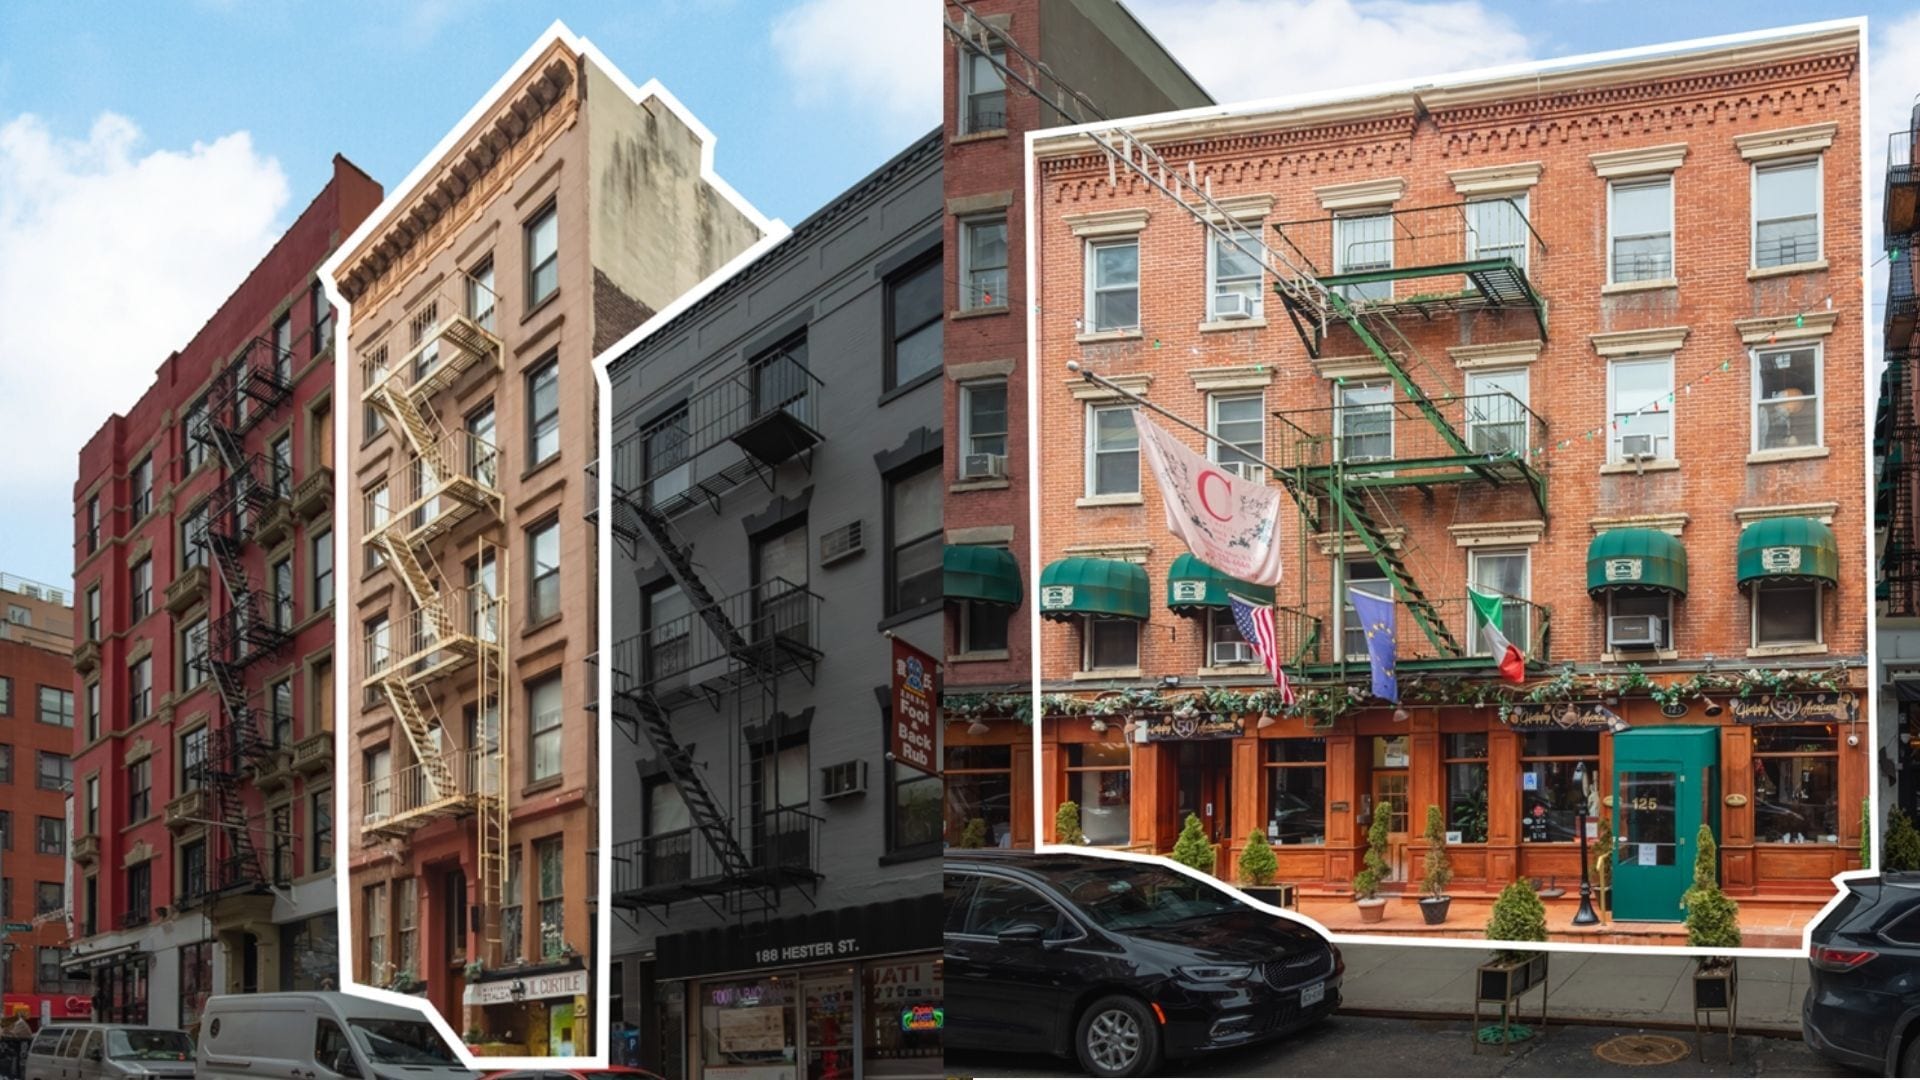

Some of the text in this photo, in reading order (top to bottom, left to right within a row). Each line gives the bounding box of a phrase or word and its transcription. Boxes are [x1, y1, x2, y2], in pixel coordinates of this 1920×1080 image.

[1197, 470, 1233, 522] C
[901, 701, 930, 725] Foot
[1667, 705, 1682, 714] 125
[1735, 703, 1769, 718] Happy
[1776, 699, 1796, 715] 50
[911, 720, 920, 731] &
[1178, 720, 1194, 734] 50
[898, 722, 932, 751] Back
[902, 742, 928, 766] Rub
[1632, 797, 1657, 810] 125
[755, 939, 860, 962] 188 HESTER ST.
[540, 975, 580, 994] CORTILE
